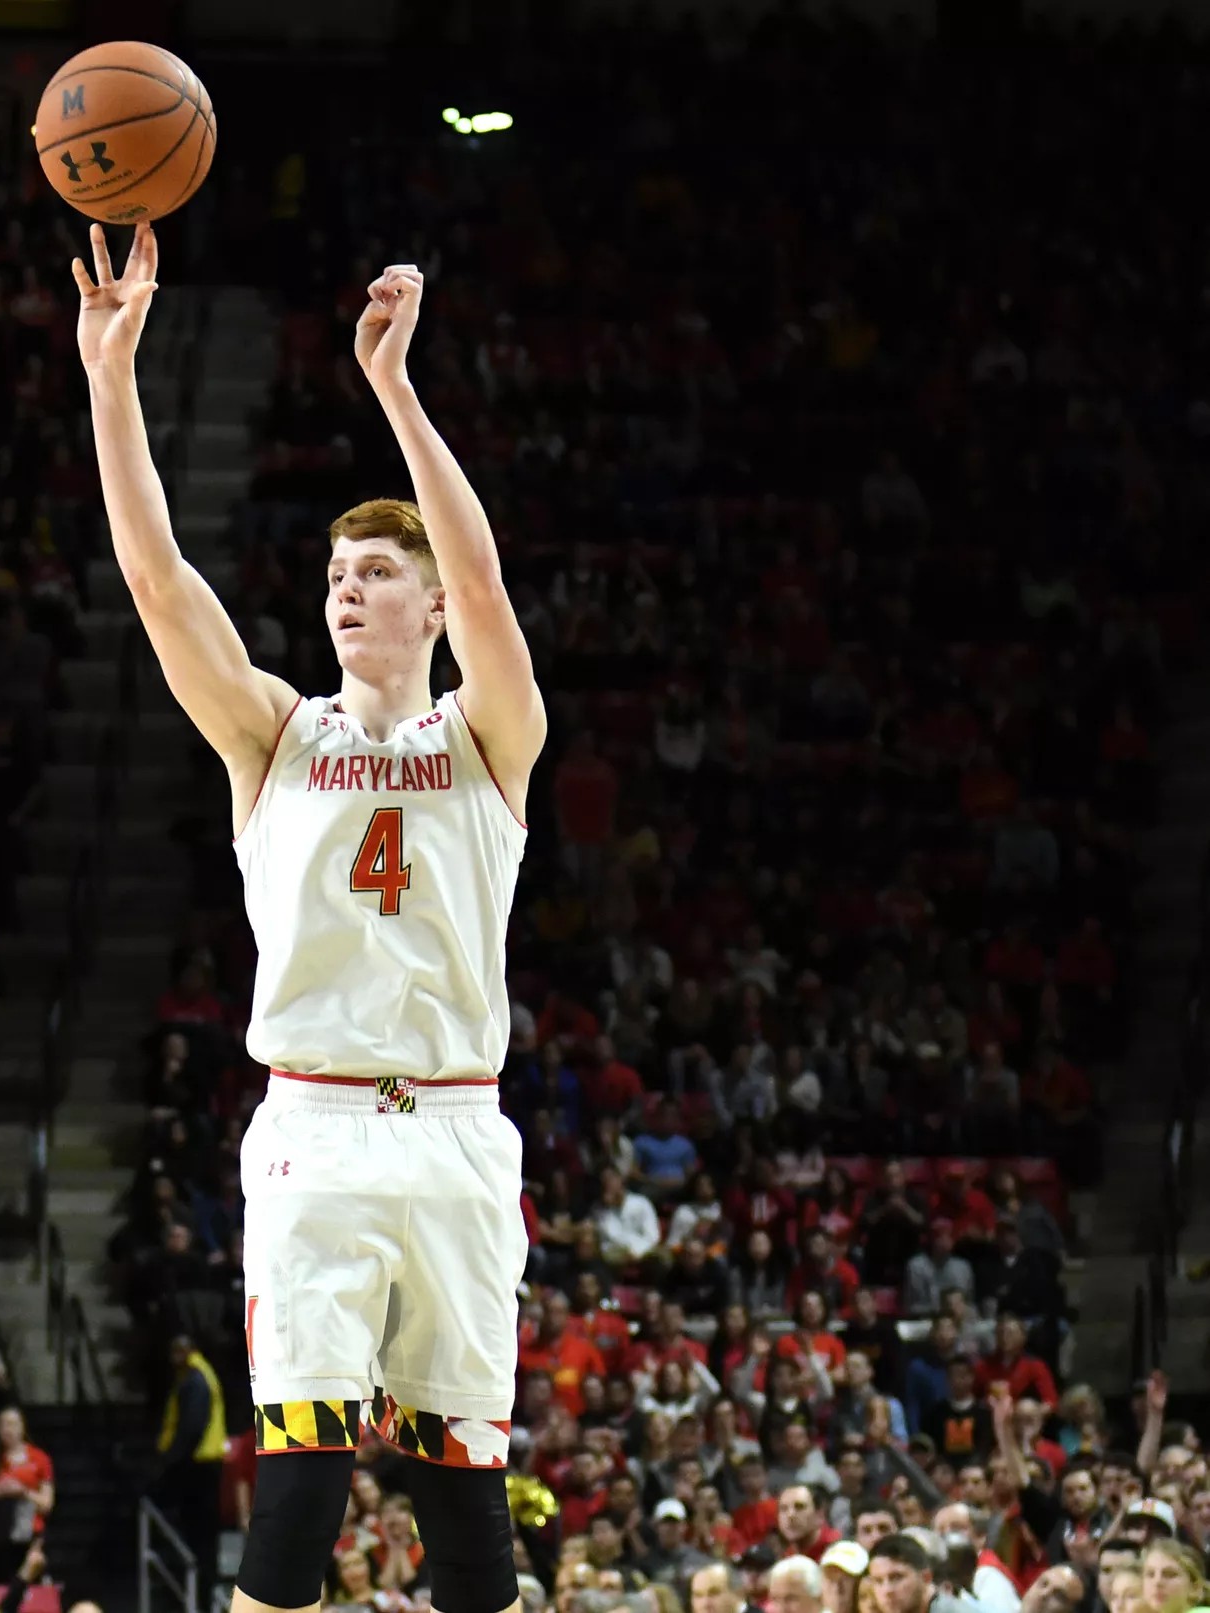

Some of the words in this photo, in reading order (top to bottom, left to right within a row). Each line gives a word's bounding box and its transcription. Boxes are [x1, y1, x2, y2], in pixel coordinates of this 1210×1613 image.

[62, 84, 86, 119] M
[307, 753, 453, 792] MARYLAND
[350, 807, 412, 916] 4
